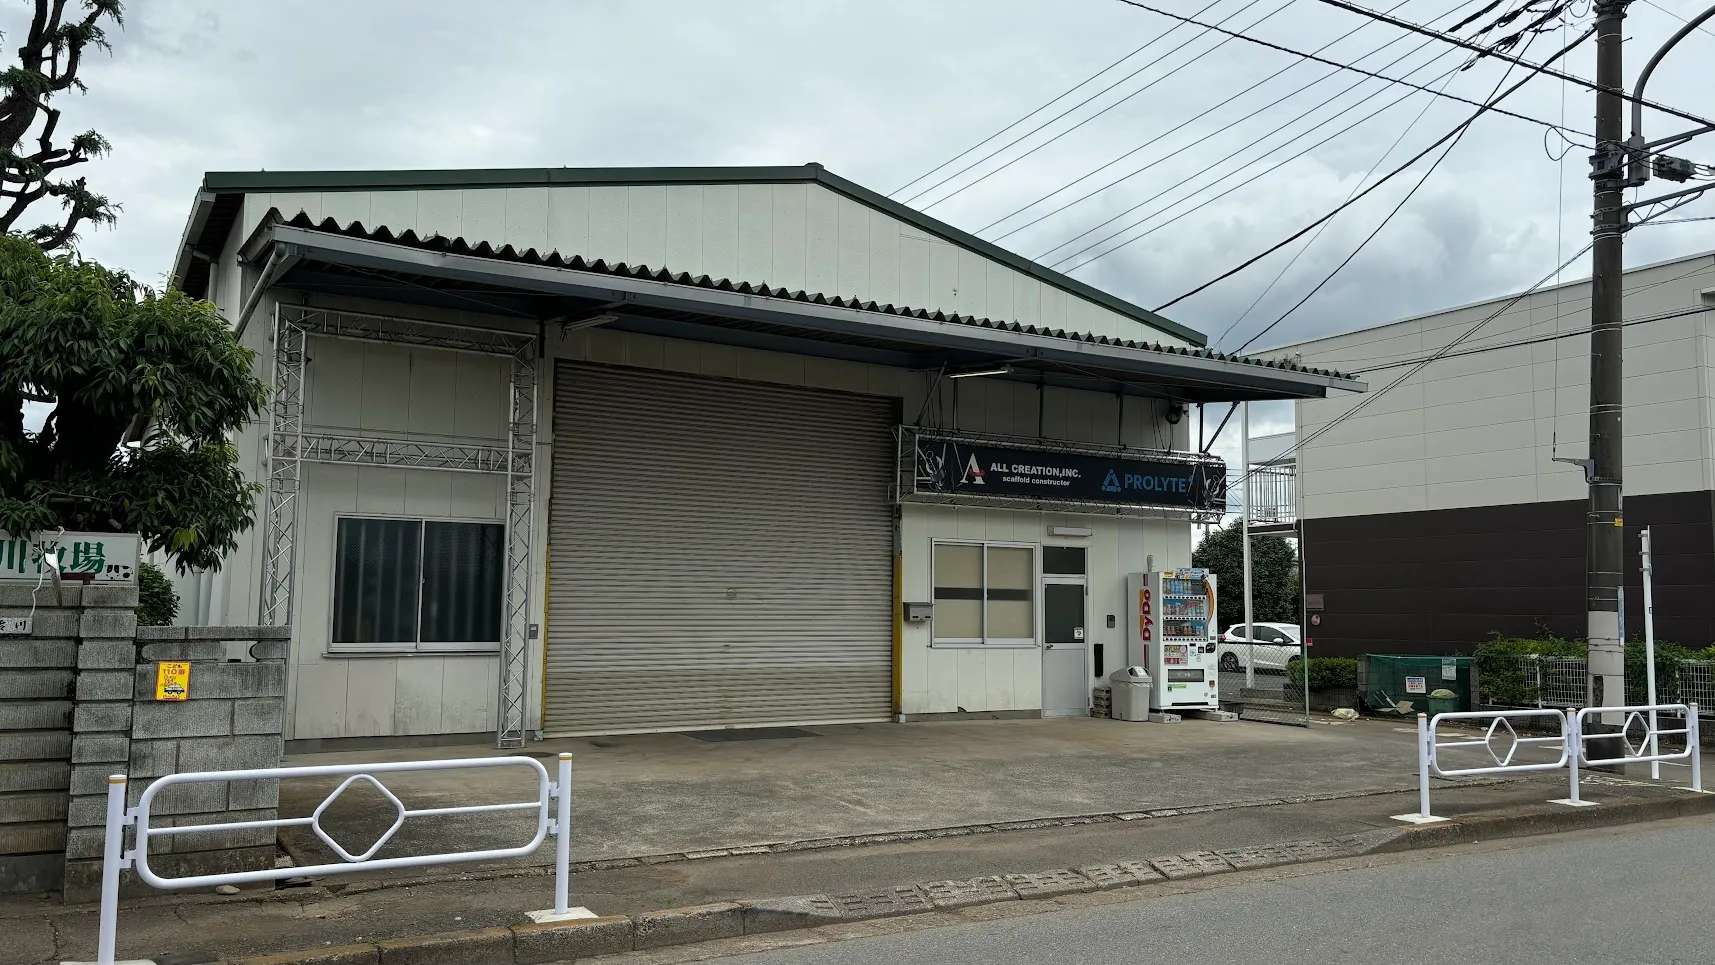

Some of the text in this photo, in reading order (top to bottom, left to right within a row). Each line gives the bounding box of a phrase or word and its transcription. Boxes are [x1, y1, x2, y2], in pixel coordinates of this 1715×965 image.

[990, 462, 1081, 478] ALL CREATION,INC.
[1002, 476, 1071, 487] scaffold constructor
[1124, 473, 1187, 493] PROLYTE
